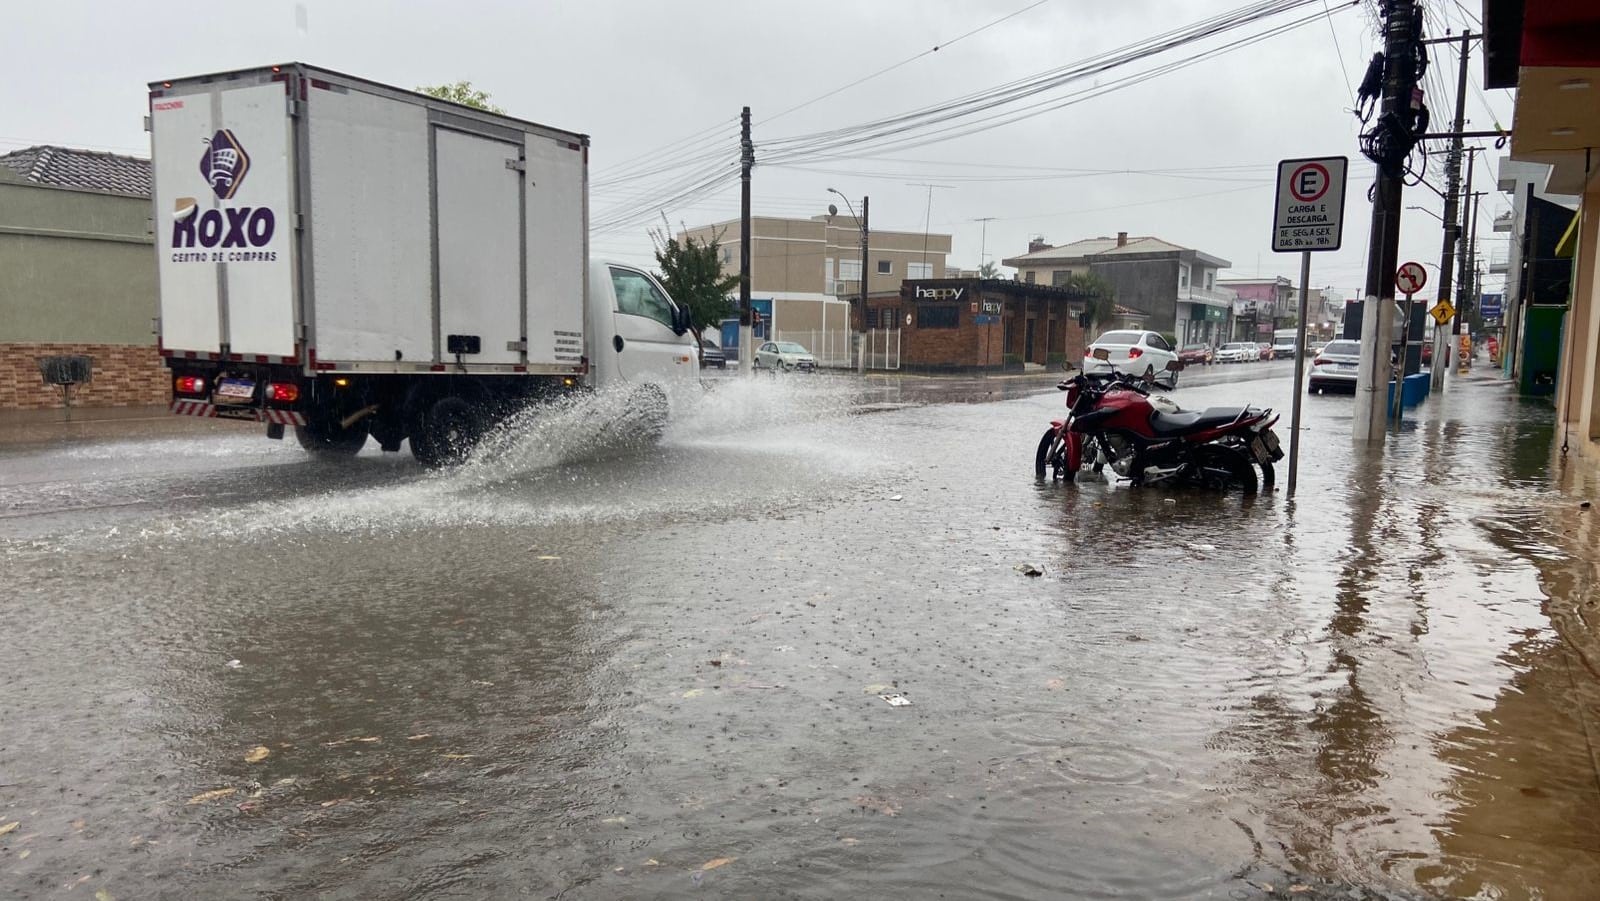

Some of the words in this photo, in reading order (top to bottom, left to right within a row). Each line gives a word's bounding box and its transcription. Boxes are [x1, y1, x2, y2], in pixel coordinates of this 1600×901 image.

[1300, 171, 1317, 194] E
[1288, 205, 1316, 214] CARGA
[171, 197, 275, 248] ROXO
[1287, 214, 1328, 224] DESCARGA
[1280, 238, 1292, 247] DAS
[171, 252, 208, 263] CENTRO
[212, 251, 224, 262] DE
[228, 251, 277, 262] COMPRAS
[916, 285, 964, 300] happy
